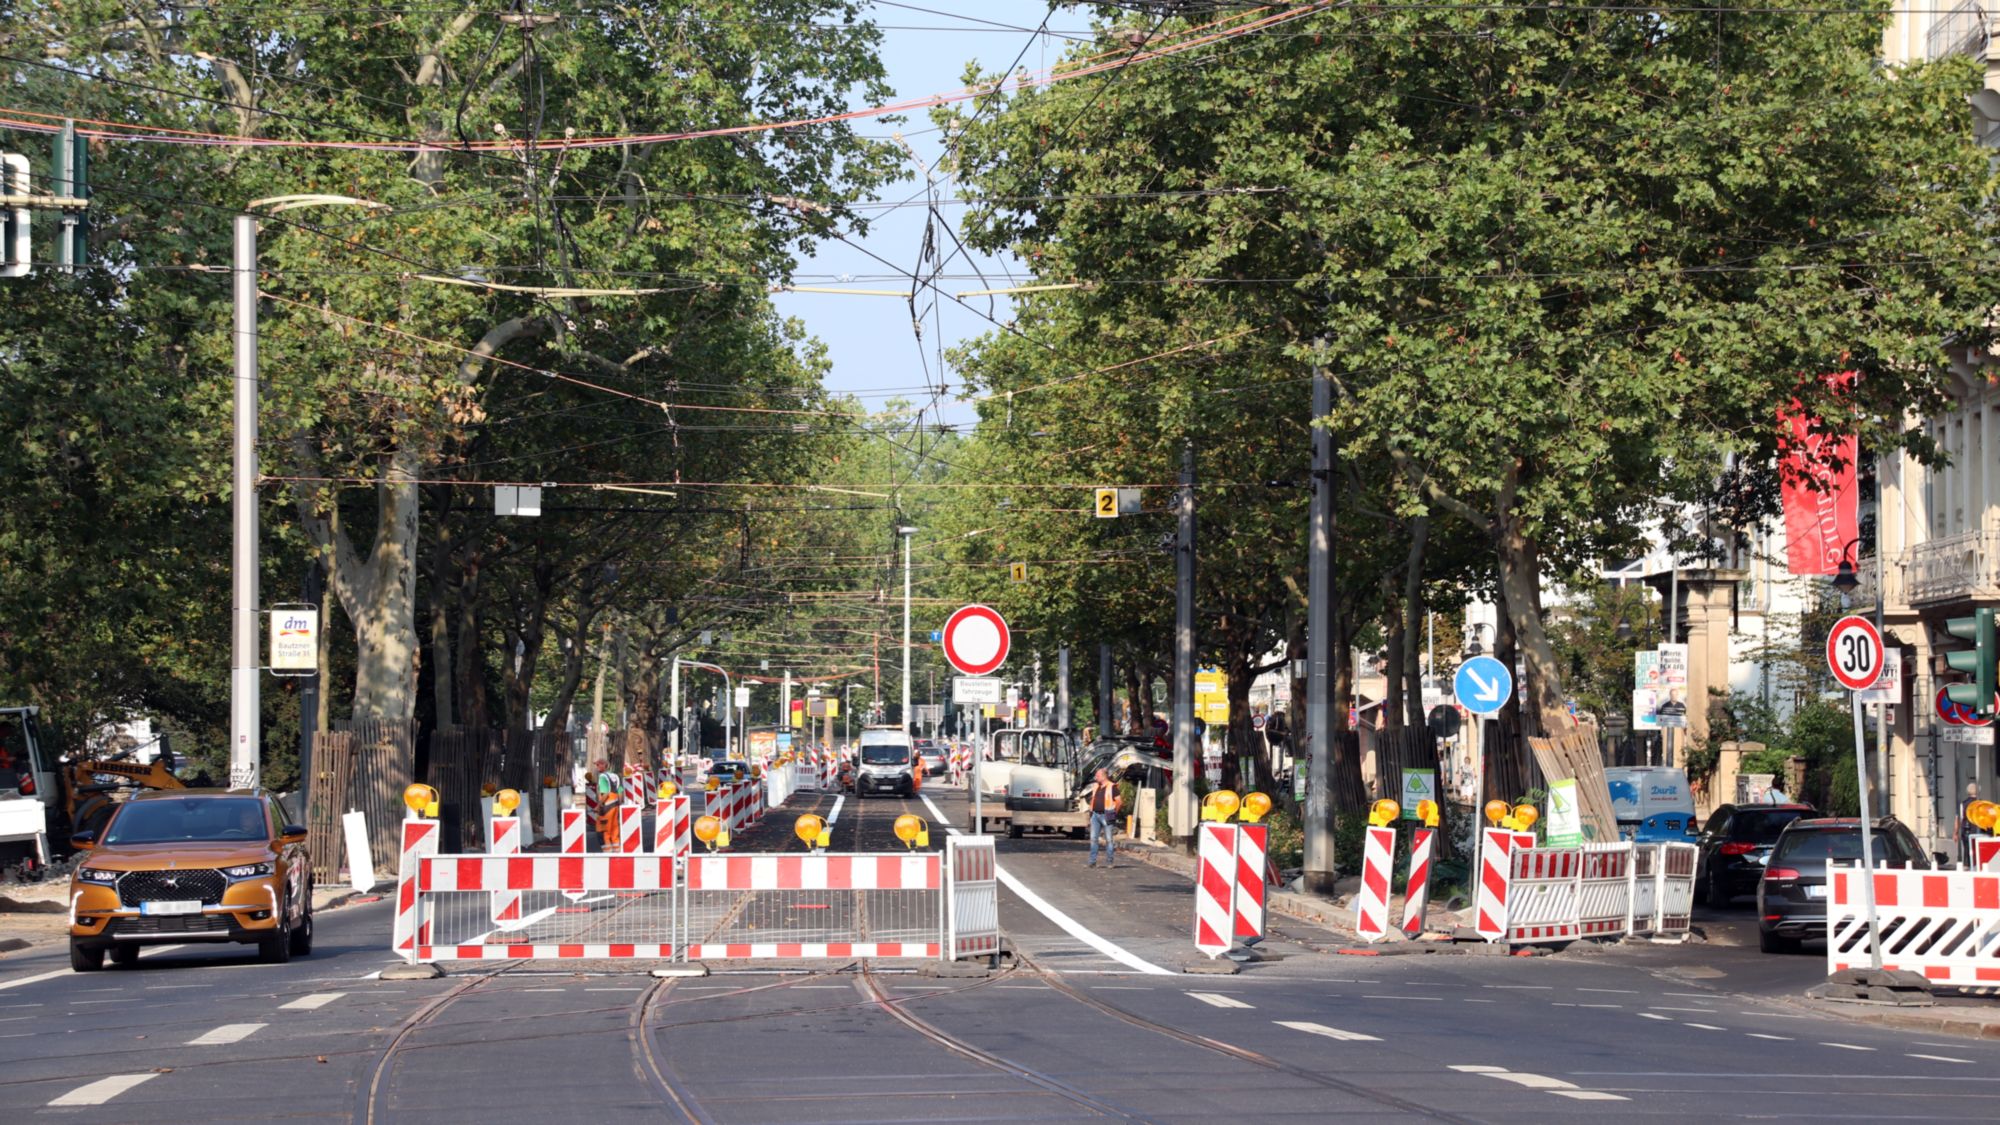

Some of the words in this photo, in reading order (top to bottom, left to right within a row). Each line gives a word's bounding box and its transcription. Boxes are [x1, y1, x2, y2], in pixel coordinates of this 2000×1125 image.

[1102, 495, 1113, 511] 2
[1015, 567, 1022, 579] 1
[284, 616, 307, 630] dm
[1842, 634, 1870, 672] 30
[93, 762, 152, 775] LIEBHERR
